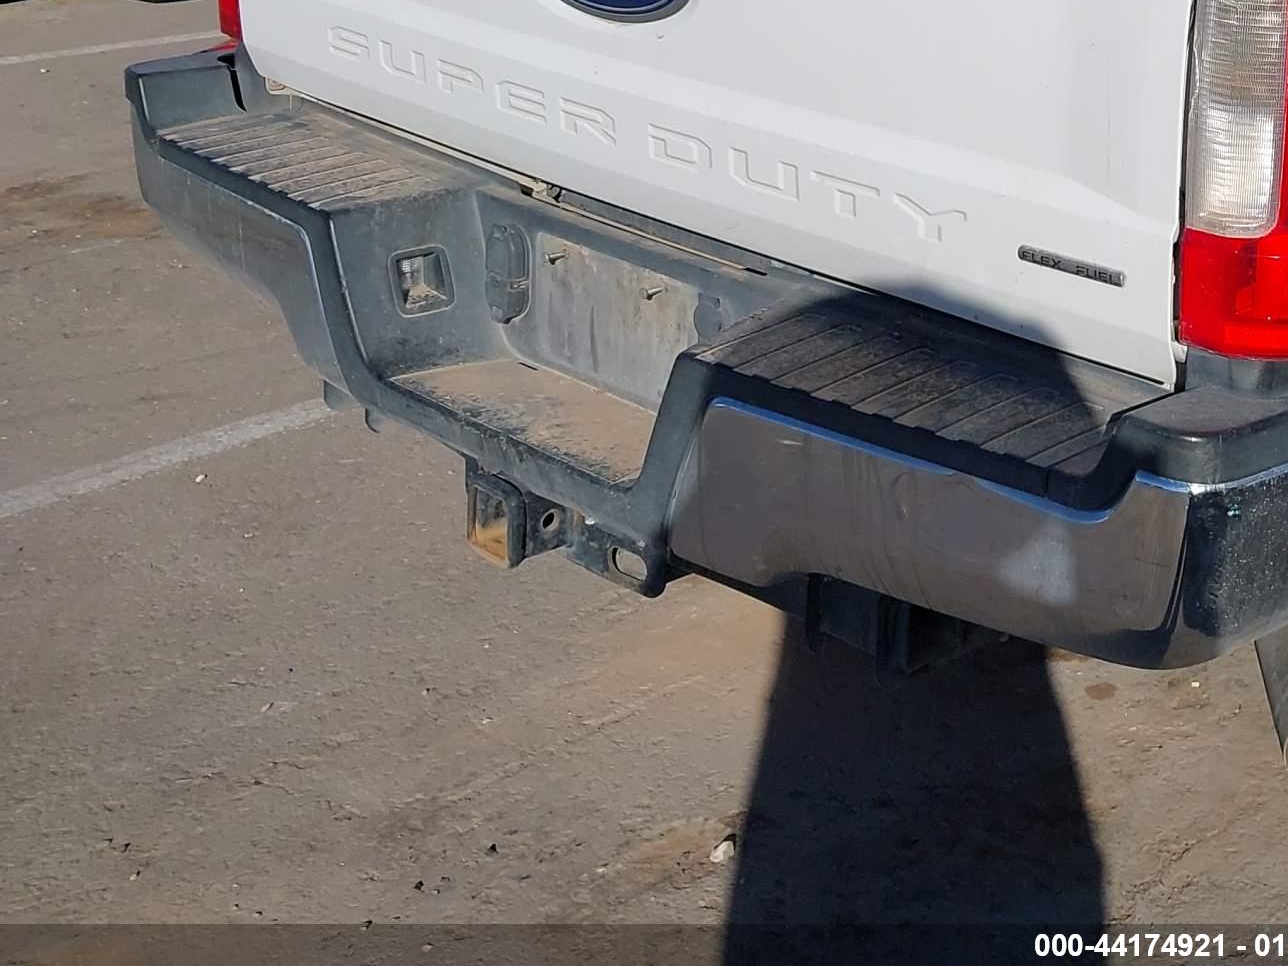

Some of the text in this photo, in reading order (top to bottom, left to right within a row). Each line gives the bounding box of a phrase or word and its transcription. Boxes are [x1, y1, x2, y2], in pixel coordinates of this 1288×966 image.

[327, 25, 968, 243] SUPER DUTY
[1021, 250, 1121, 286] FLEX FUEL
